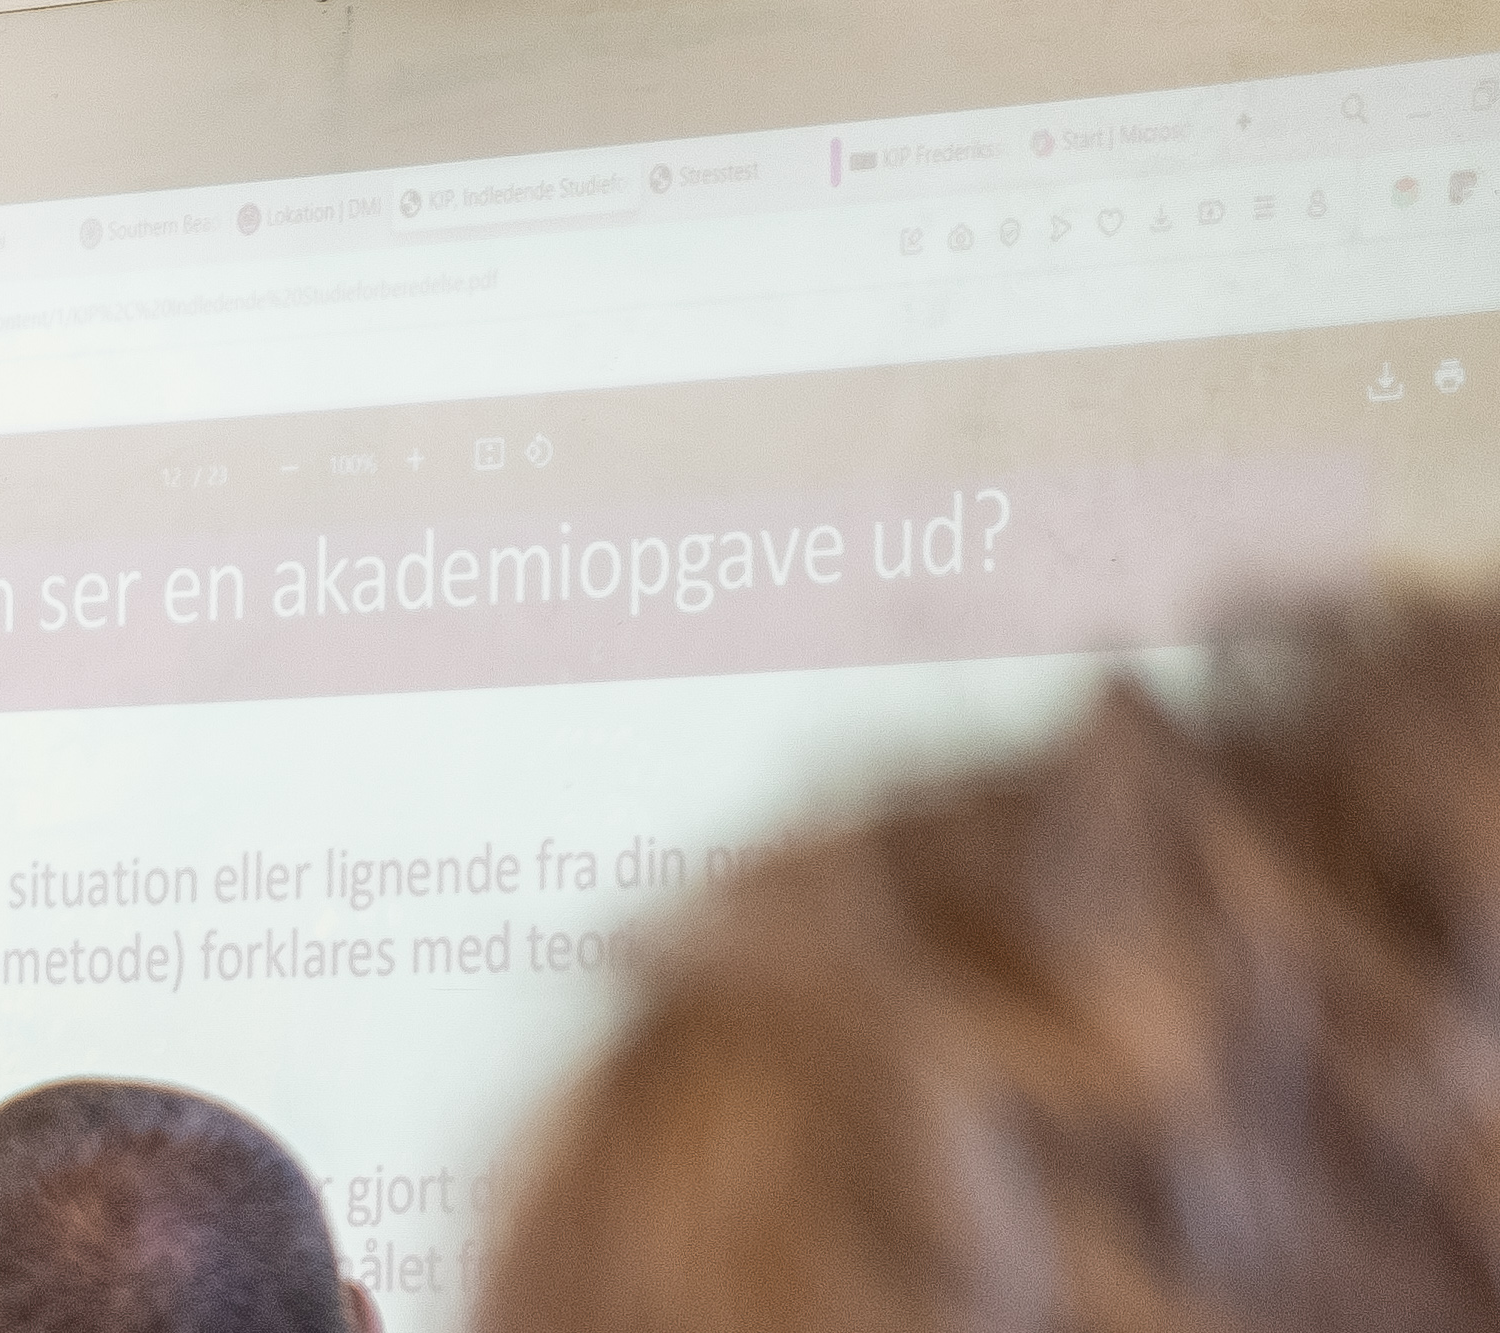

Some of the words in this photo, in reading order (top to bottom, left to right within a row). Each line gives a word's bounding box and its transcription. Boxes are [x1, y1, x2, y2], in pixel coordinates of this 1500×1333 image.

[916, 143, 1005, 166] Frederiks
[40, 570, 141, 632] ser
[165, 564, 245, 624] en
[272, 522, 844, 615] akademiopgave
[873, 486, 1012, 579] ud?
[8, 858, 198, 909] situation
[213, 852, 312, 904] eller
[325, 842, 521, 911] lignende
[536, 837, 598, 893] fra
[614, 835, 688, 890] din
[2, 930, 185, 994] metode)
[200, 928, 396, 980] forklares
[411, 921, 511, 976] med
[346, 1164, 454, 1228] gjort
[342, 1238, 442, 1293] ålet
